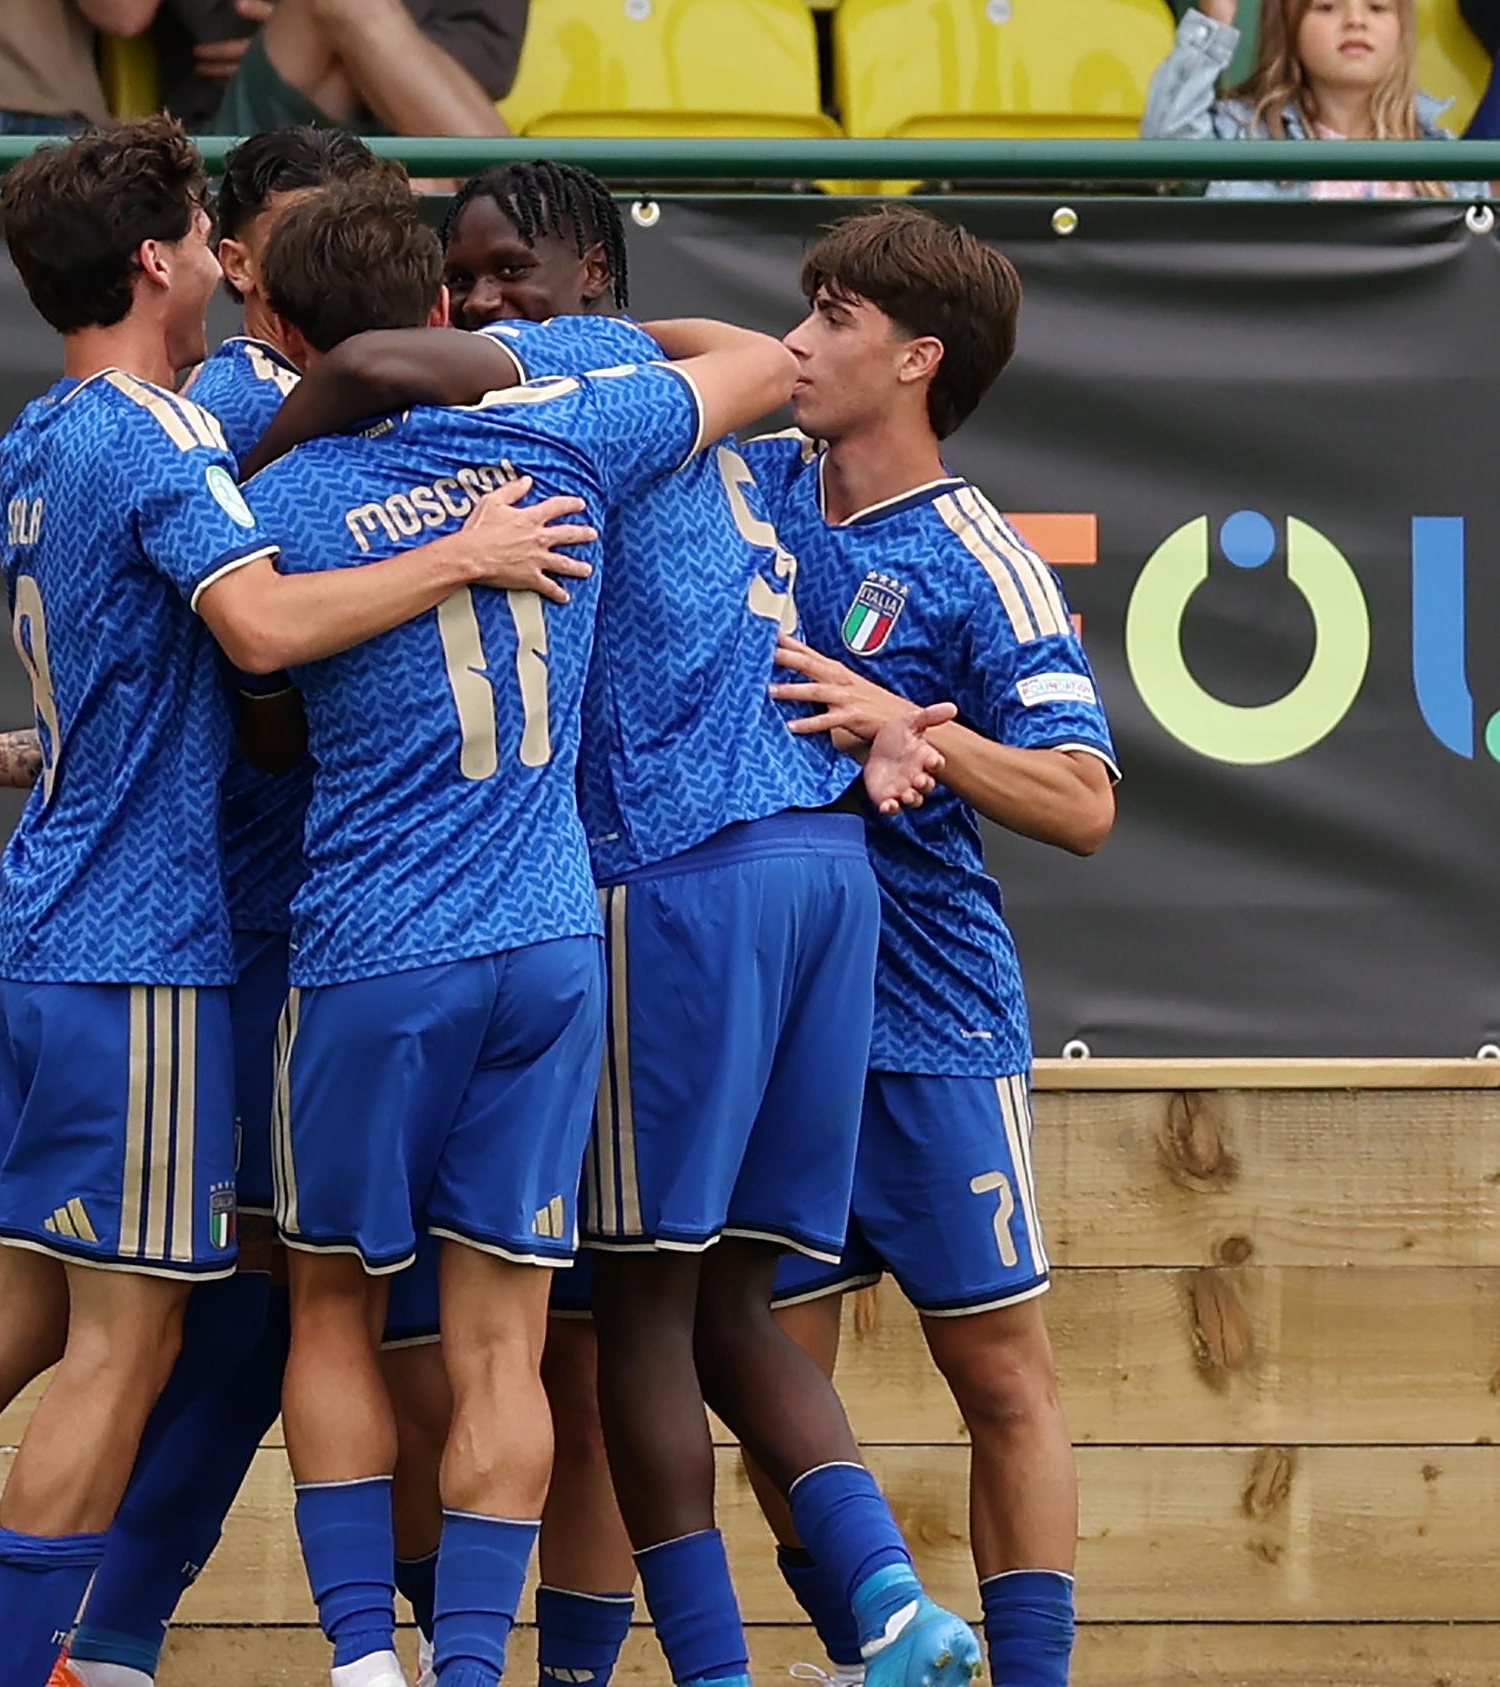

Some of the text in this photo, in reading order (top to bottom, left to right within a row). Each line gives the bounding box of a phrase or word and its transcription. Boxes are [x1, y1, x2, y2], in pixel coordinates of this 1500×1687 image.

[861, 586, 898, 613] ITALIA
[438, 587, 551, 780] 11
[970, 1171, 1018, 1267] 7
